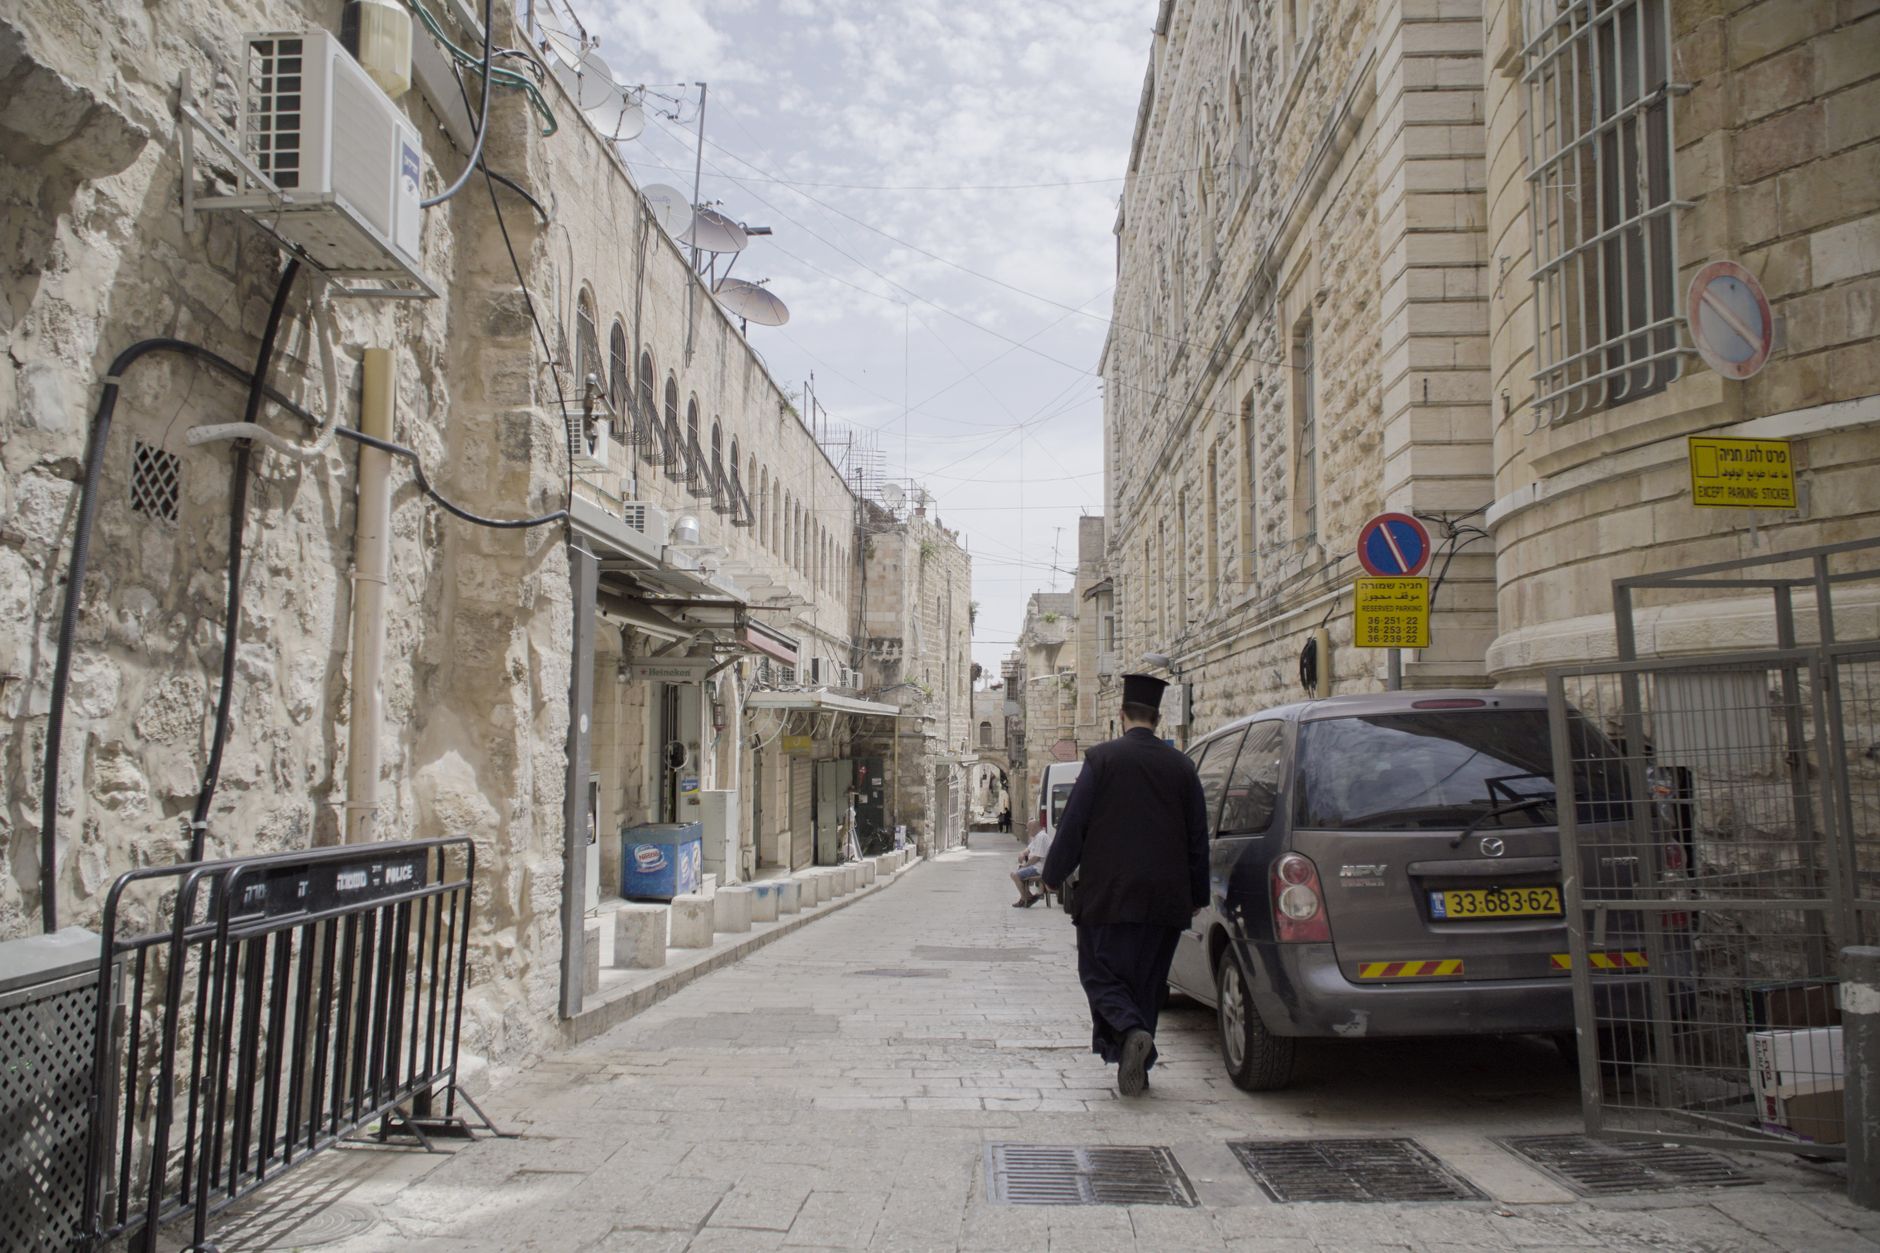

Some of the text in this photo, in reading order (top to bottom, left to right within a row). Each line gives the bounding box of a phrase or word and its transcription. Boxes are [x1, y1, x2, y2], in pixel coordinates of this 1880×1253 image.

[1719, 448, 1742, 461] חניה
[1766, 450, 1785, 463] פרט
[1698, 485, 1790, 500] EXCEPT PARKING STICKER
[1360, 582, 1395, 590] שמורה
[1395, 592, 1420, 601] موقف
[648, 667, 691, 677] Heineken
[385, 865, 413, 884] POLICE
[1339, 864, 1388, 877] MPV
